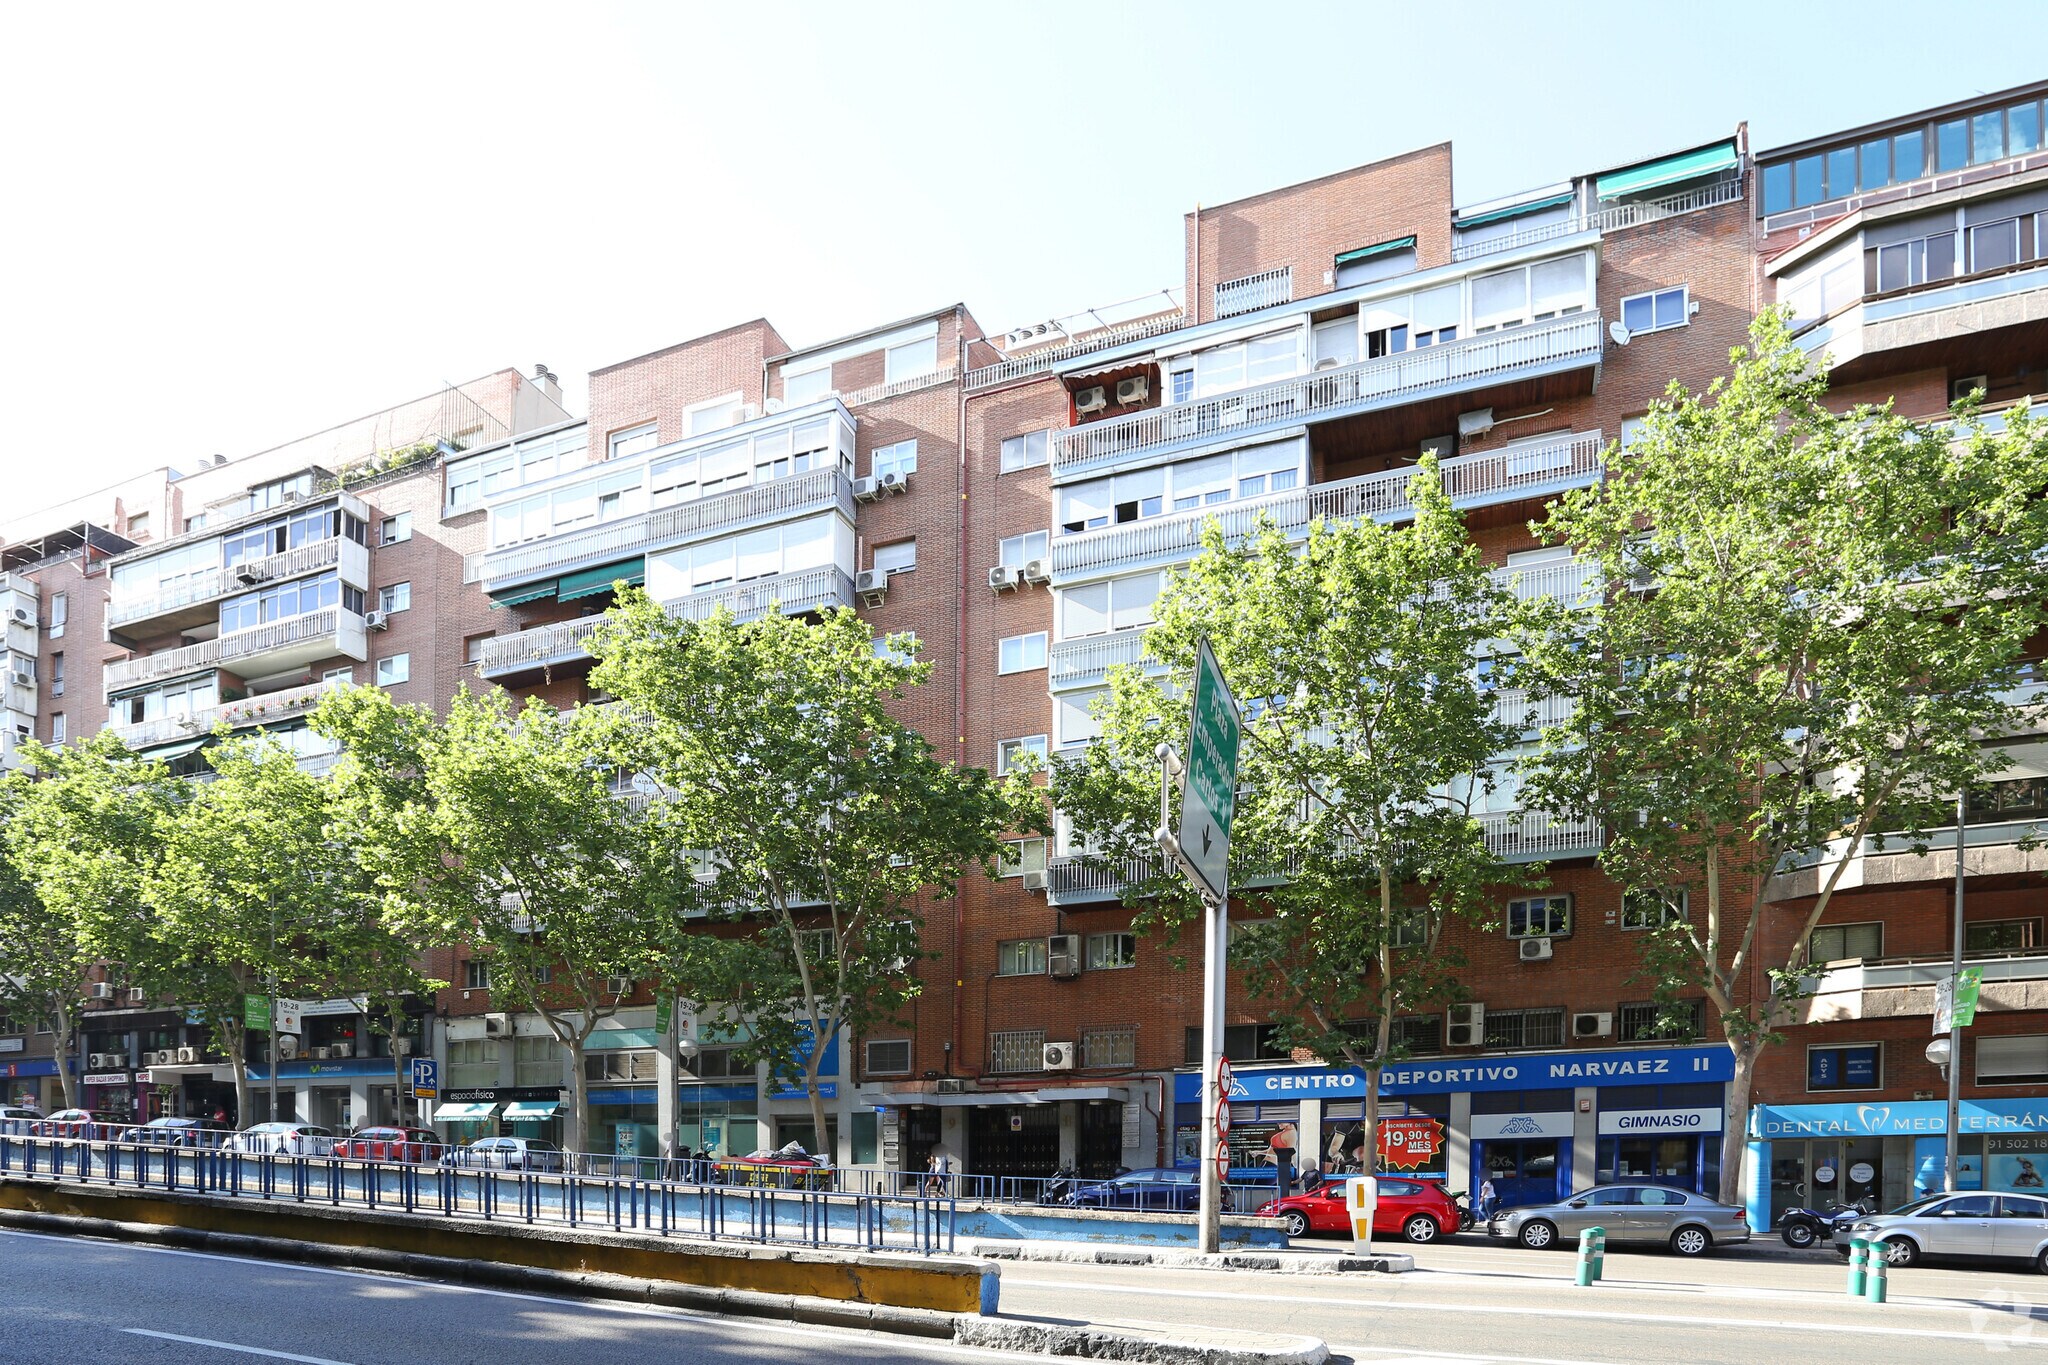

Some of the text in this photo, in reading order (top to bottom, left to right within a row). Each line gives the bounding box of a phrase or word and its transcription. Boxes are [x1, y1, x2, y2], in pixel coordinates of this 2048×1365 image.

[1211, 687, 1228, 740] Plaza
[1196, 708, 1233, 792] Emperador
[1195, 757, 1218, 812] Carlos
[279, 1001, 300, 1011] 19-28
[680, 1001, 696, 1011] 19-28
[418, 1063, 433, 1085] P
[1265, 1074, 1356, 1090] CENTRO
[1381, 1066, 1518, 1085] DEPORTIVO
[1550, 1059, 1669, 1078] NARVAEZ
[1693, 1057, 1709, 1072] II
[1820, 1058, 1828, 1079] ADYS
[1618, 1114, 1701, 1129] GIMNASIO
[1767, 1111, 2048, 1134] DENTAL MEDTERRÁN
[1408, 1141, 1431, 1149] MES
[1989, 1138, 2047, 1149] 91 502 18
